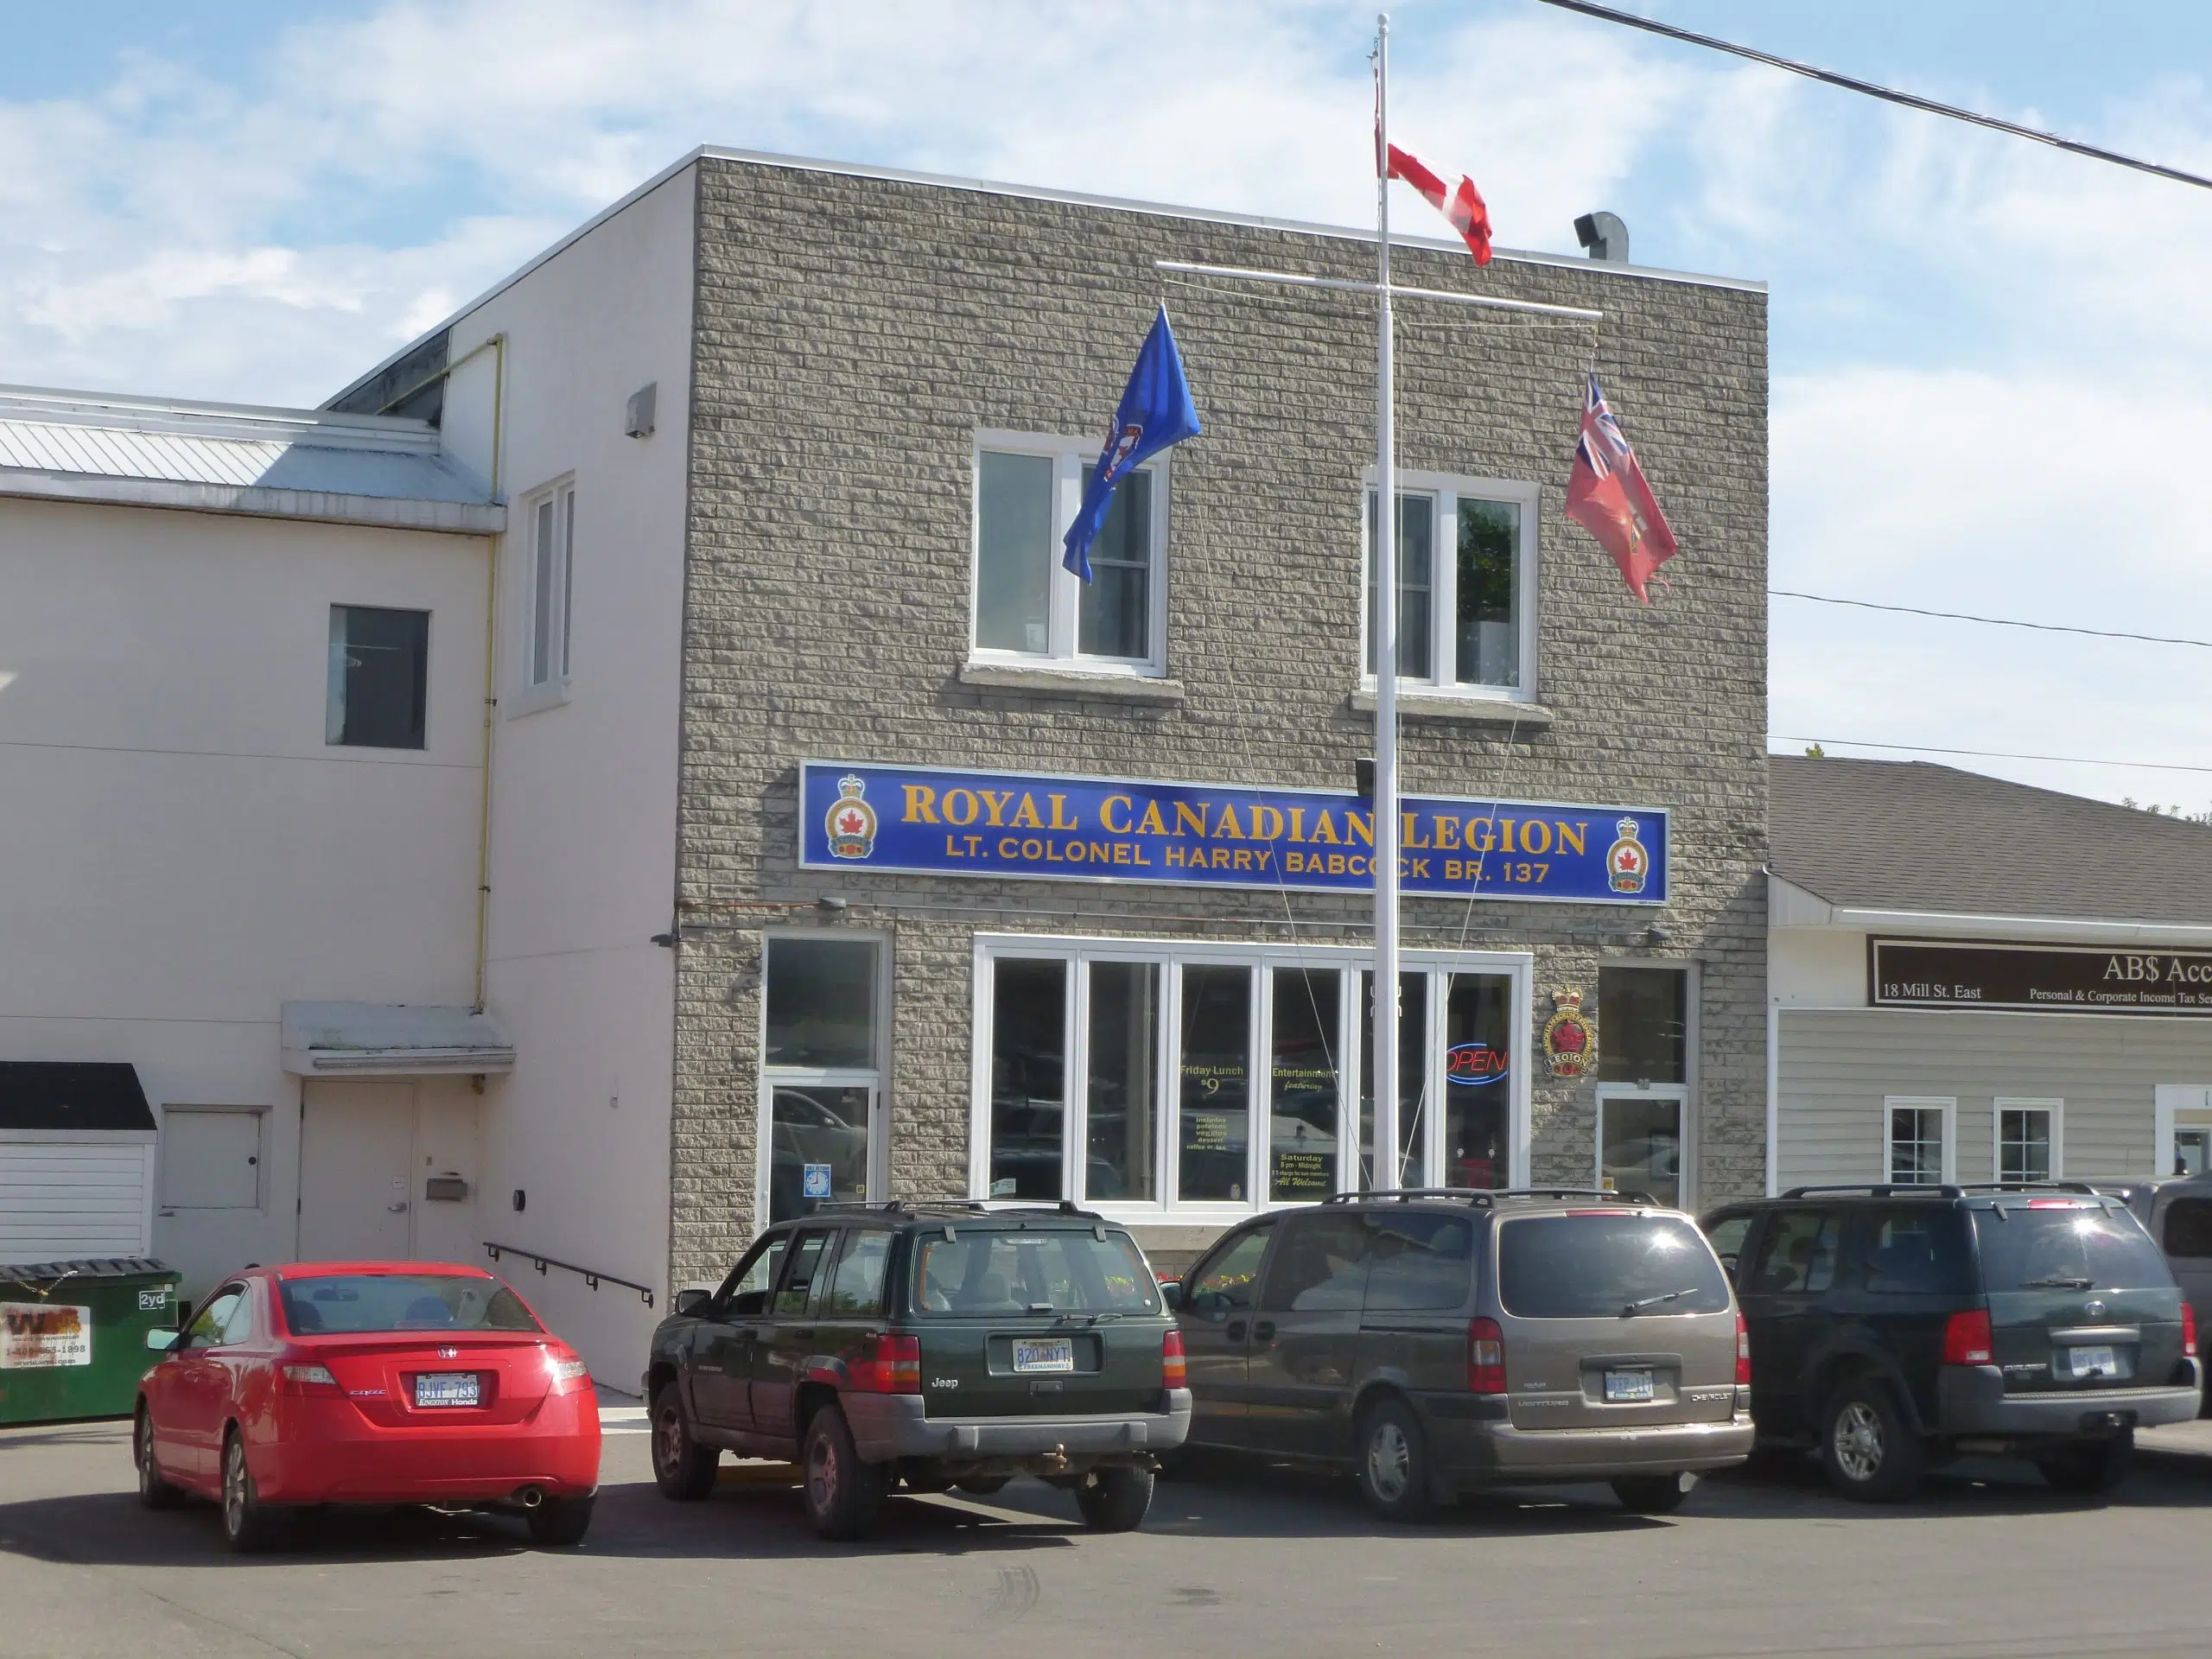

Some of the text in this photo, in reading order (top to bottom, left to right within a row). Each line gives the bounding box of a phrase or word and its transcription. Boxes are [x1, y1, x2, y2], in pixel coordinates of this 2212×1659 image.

[901, 784, 1588, 855] ROYAL CANADIAN LEGION
[946, 836, 988, 858] LT.
[998, 837, 1151, 866] COLONEL
[1166, 846, 1272, 872] HARRY
[1445, 861, 1491, 881] BR.
[1503, 863, 1549, 883] 137
[2103, 955, 2159, 984] AB$
[1884, 982, 1981, 999] 18 Mill St. East
[2030, 988, 2072, 1001] Personal
[2075, 990, 2085, 1001] &
[2088, 990, 2137, 1004] Corporate
[2139, 991, 2176, 1003] Income
[2177, 992, 2196, 1003] Tax
[1548, 1052, 1589, 1067] LEGION
[1180, 1065, 1243, 1076] Friday Lunch
[1281, 1154, 1323, 1162] Saturday
[141, 1293, 164, 1306] 2yd
[931, 1378, 958, 1389] Jeep
